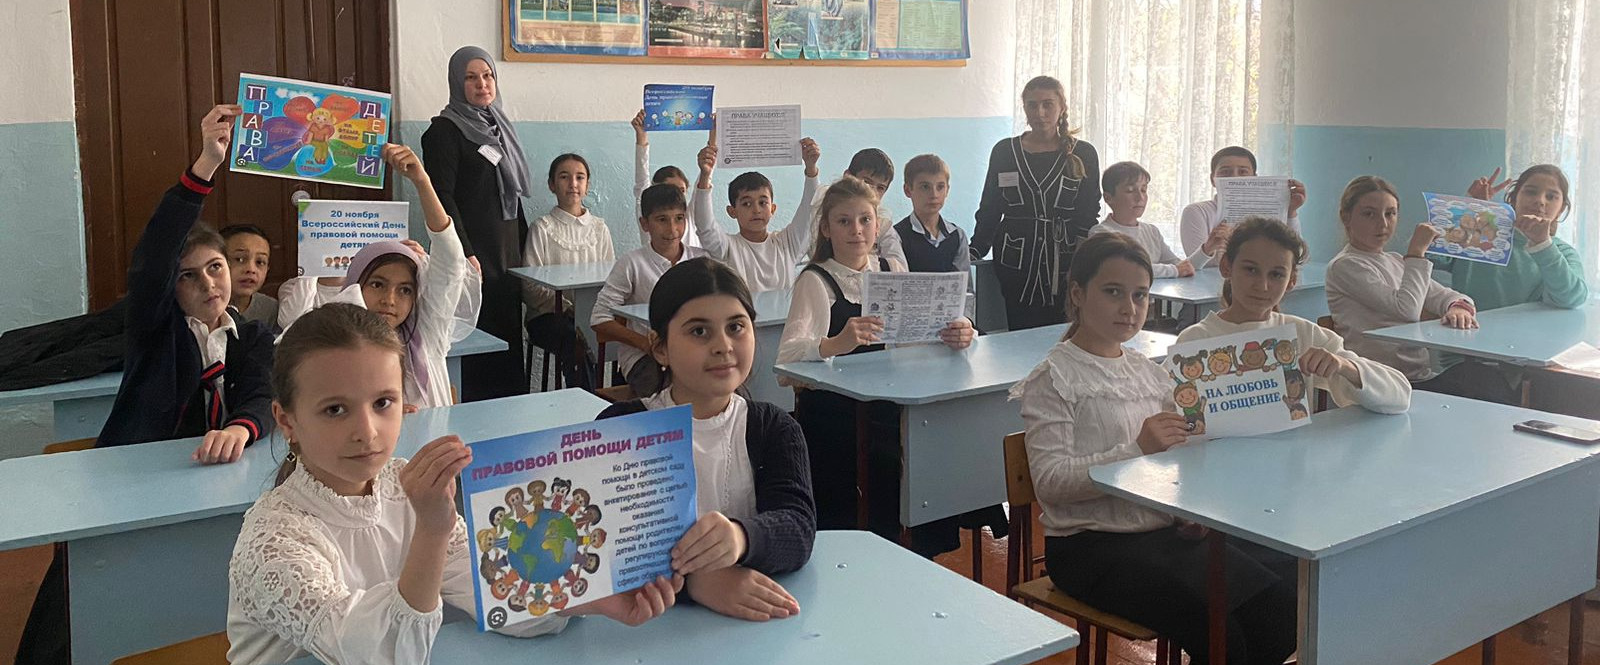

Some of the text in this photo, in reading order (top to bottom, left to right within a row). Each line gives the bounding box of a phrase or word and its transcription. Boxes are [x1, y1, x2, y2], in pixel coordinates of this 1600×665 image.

[243, 85, 269, 161] ПРАВА
[361, 103, 381, 175] ДЕТЕЙ
[330, 210, 380, 220] 20 ноября
[301, 220, 406, 230] Всероссийский День
[310, 230, 358, 240] правовой
[1205, 378, 1279, 399] НА ЛЮБОВЬ
[1208, 392, 1281, 414] И ОБЩЕНИЕ
[560, 429, 602, 448] ДЕНЬ
[471, 428, 684, 481] ПРАВОВОЙ ПОМОЩИ ДЕТЯМ
[612, 454, 673, 473] Ко Дню правовой
[602, 472, 631, 485] помощи
[638, 465, 667, 478] детском
[615, 475, 674, 493] было проведено
[604, 487, 658, 506] анкетирование
[665, 481, 688, 493] целью
[620, 495, 675, 513] необходимости
[632, 507, 665, 521] оказания
[618, 514, 679, 534] консультативной
[614, 534, 645, 546] помощи
[615, 544, 637, 557] детей
